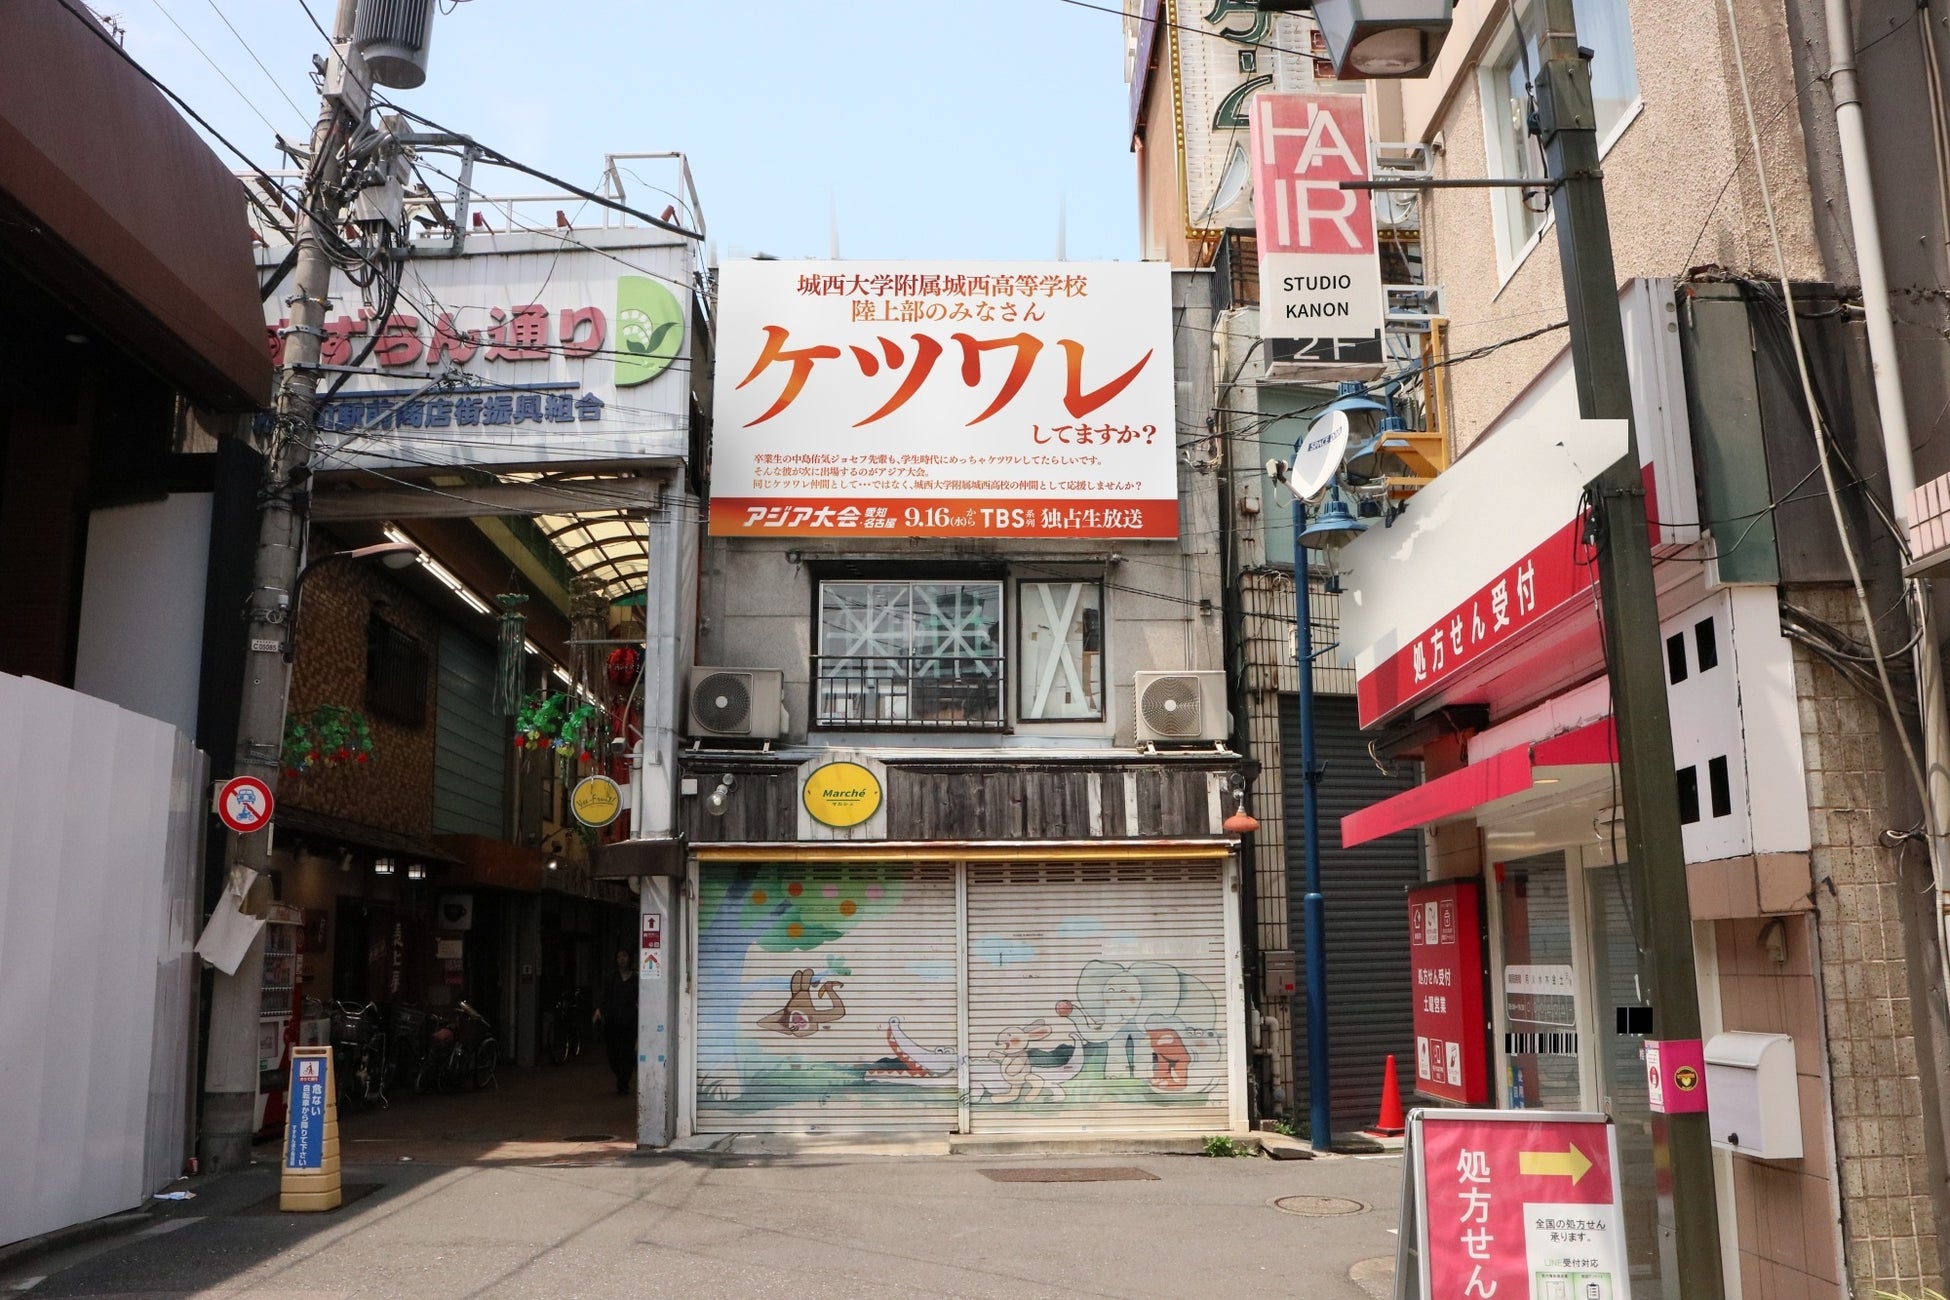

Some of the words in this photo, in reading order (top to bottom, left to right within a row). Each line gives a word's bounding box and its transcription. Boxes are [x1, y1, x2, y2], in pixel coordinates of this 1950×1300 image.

[796, 273, 1088, 298] 城西大学附属城西高等学校
[1283, 274, 1351, 292] STUDIO
[851, 299, 1046, 324] 陸上部のみなさん
[1286, 301, 1350, 319] KANON
[266, 304, 607, 369] ずらん通り
[735, 325, 1154, 428] ケツワレ
[1032, 424, 1157, 446] してますか？
[754, 466, 930, 478] そんな彼が次に出場するのがアジア大会。
[743, 506, 862, 528] アジア大会
[1041, 508, 1143, 529] 独占生放送
[1413, 559, 1535, 684] 処方せん受付
[822, 788, 866, 798] Marché
[1418, 967, 1451, 986] 処方せん受付
[311, 1083, 322, 1116] 危ない
[1456, 1148, 1498, 1299] 処方せん
[1535, 1218, 1606, 1231] 全国の処方せん
[1550, 1232, 1592, 1243] 承ります。
